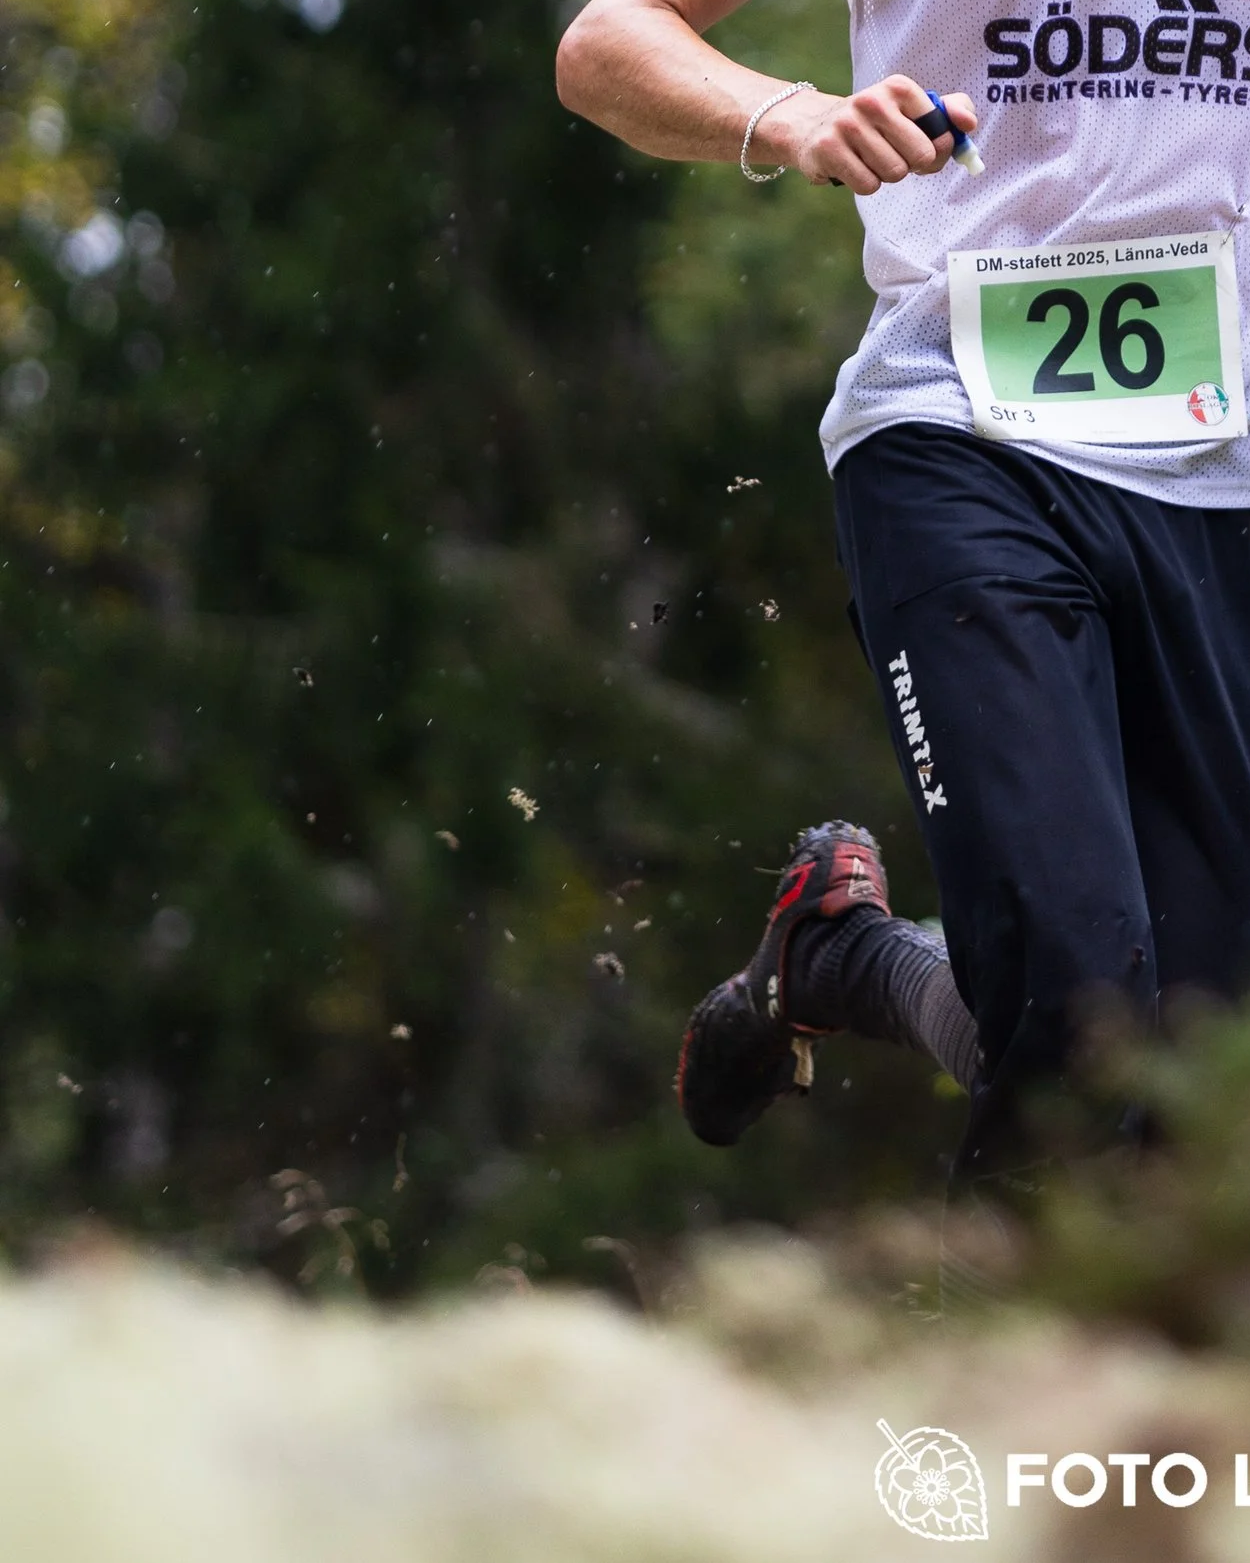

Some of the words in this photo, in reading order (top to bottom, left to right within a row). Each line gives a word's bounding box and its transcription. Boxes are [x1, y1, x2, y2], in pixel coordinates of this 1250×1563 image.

[976, 252, 1062, 272] DM-stafett
[1066, 250, 1110, 267] 2025,
[1115, 240, 1209, 263] Länna-Veda
[1026, 281, 1166, 395] 26
[989, 405, 1017, 422] Str
[1024, 409, 1036, 423] 3
[888, 649, 948, 815] TRIMTEX
